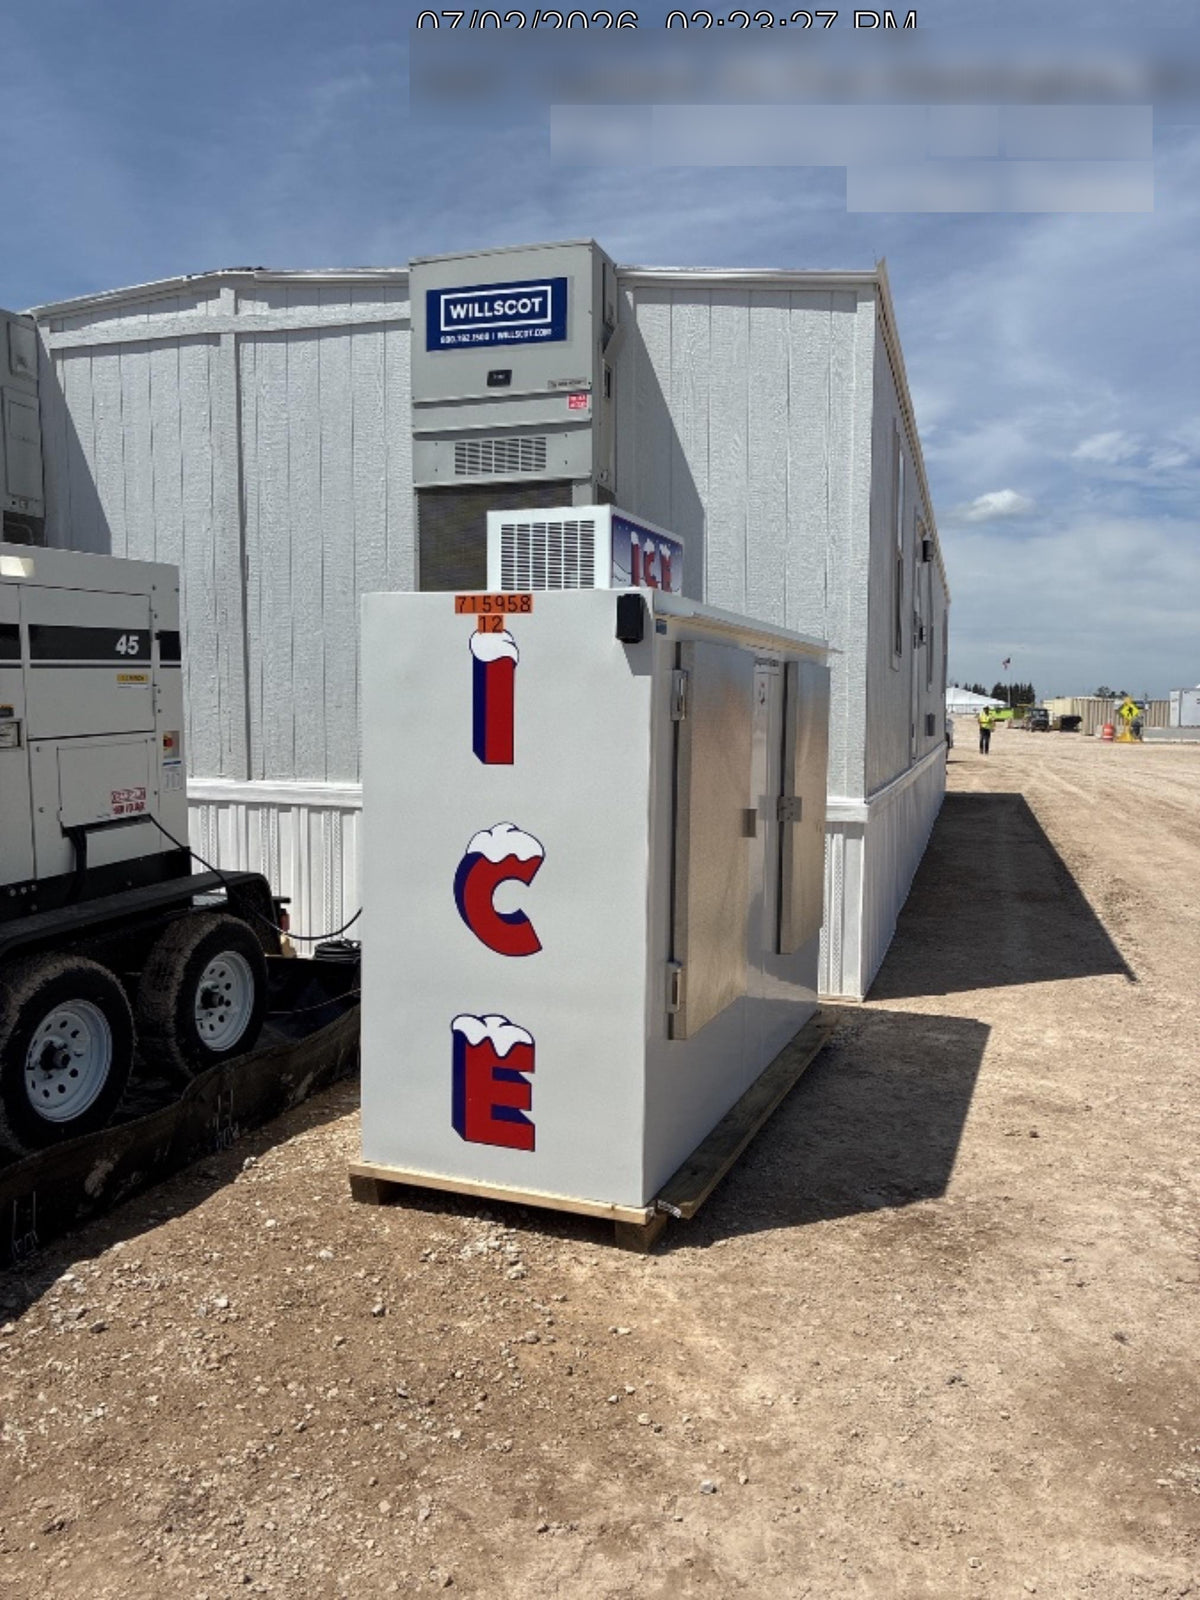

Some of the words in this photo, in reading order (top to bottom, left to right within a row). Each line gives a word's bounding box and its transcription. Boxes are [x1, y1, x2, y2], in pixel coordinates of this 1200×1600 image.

[449, 297, 543, 319] WILLSCOT
[630, 531, 672, 593] ICE
[458, 594, 531, 614] 715958
[479, 615, 503, 633] 12
[115, 634, 140, 655] 45
